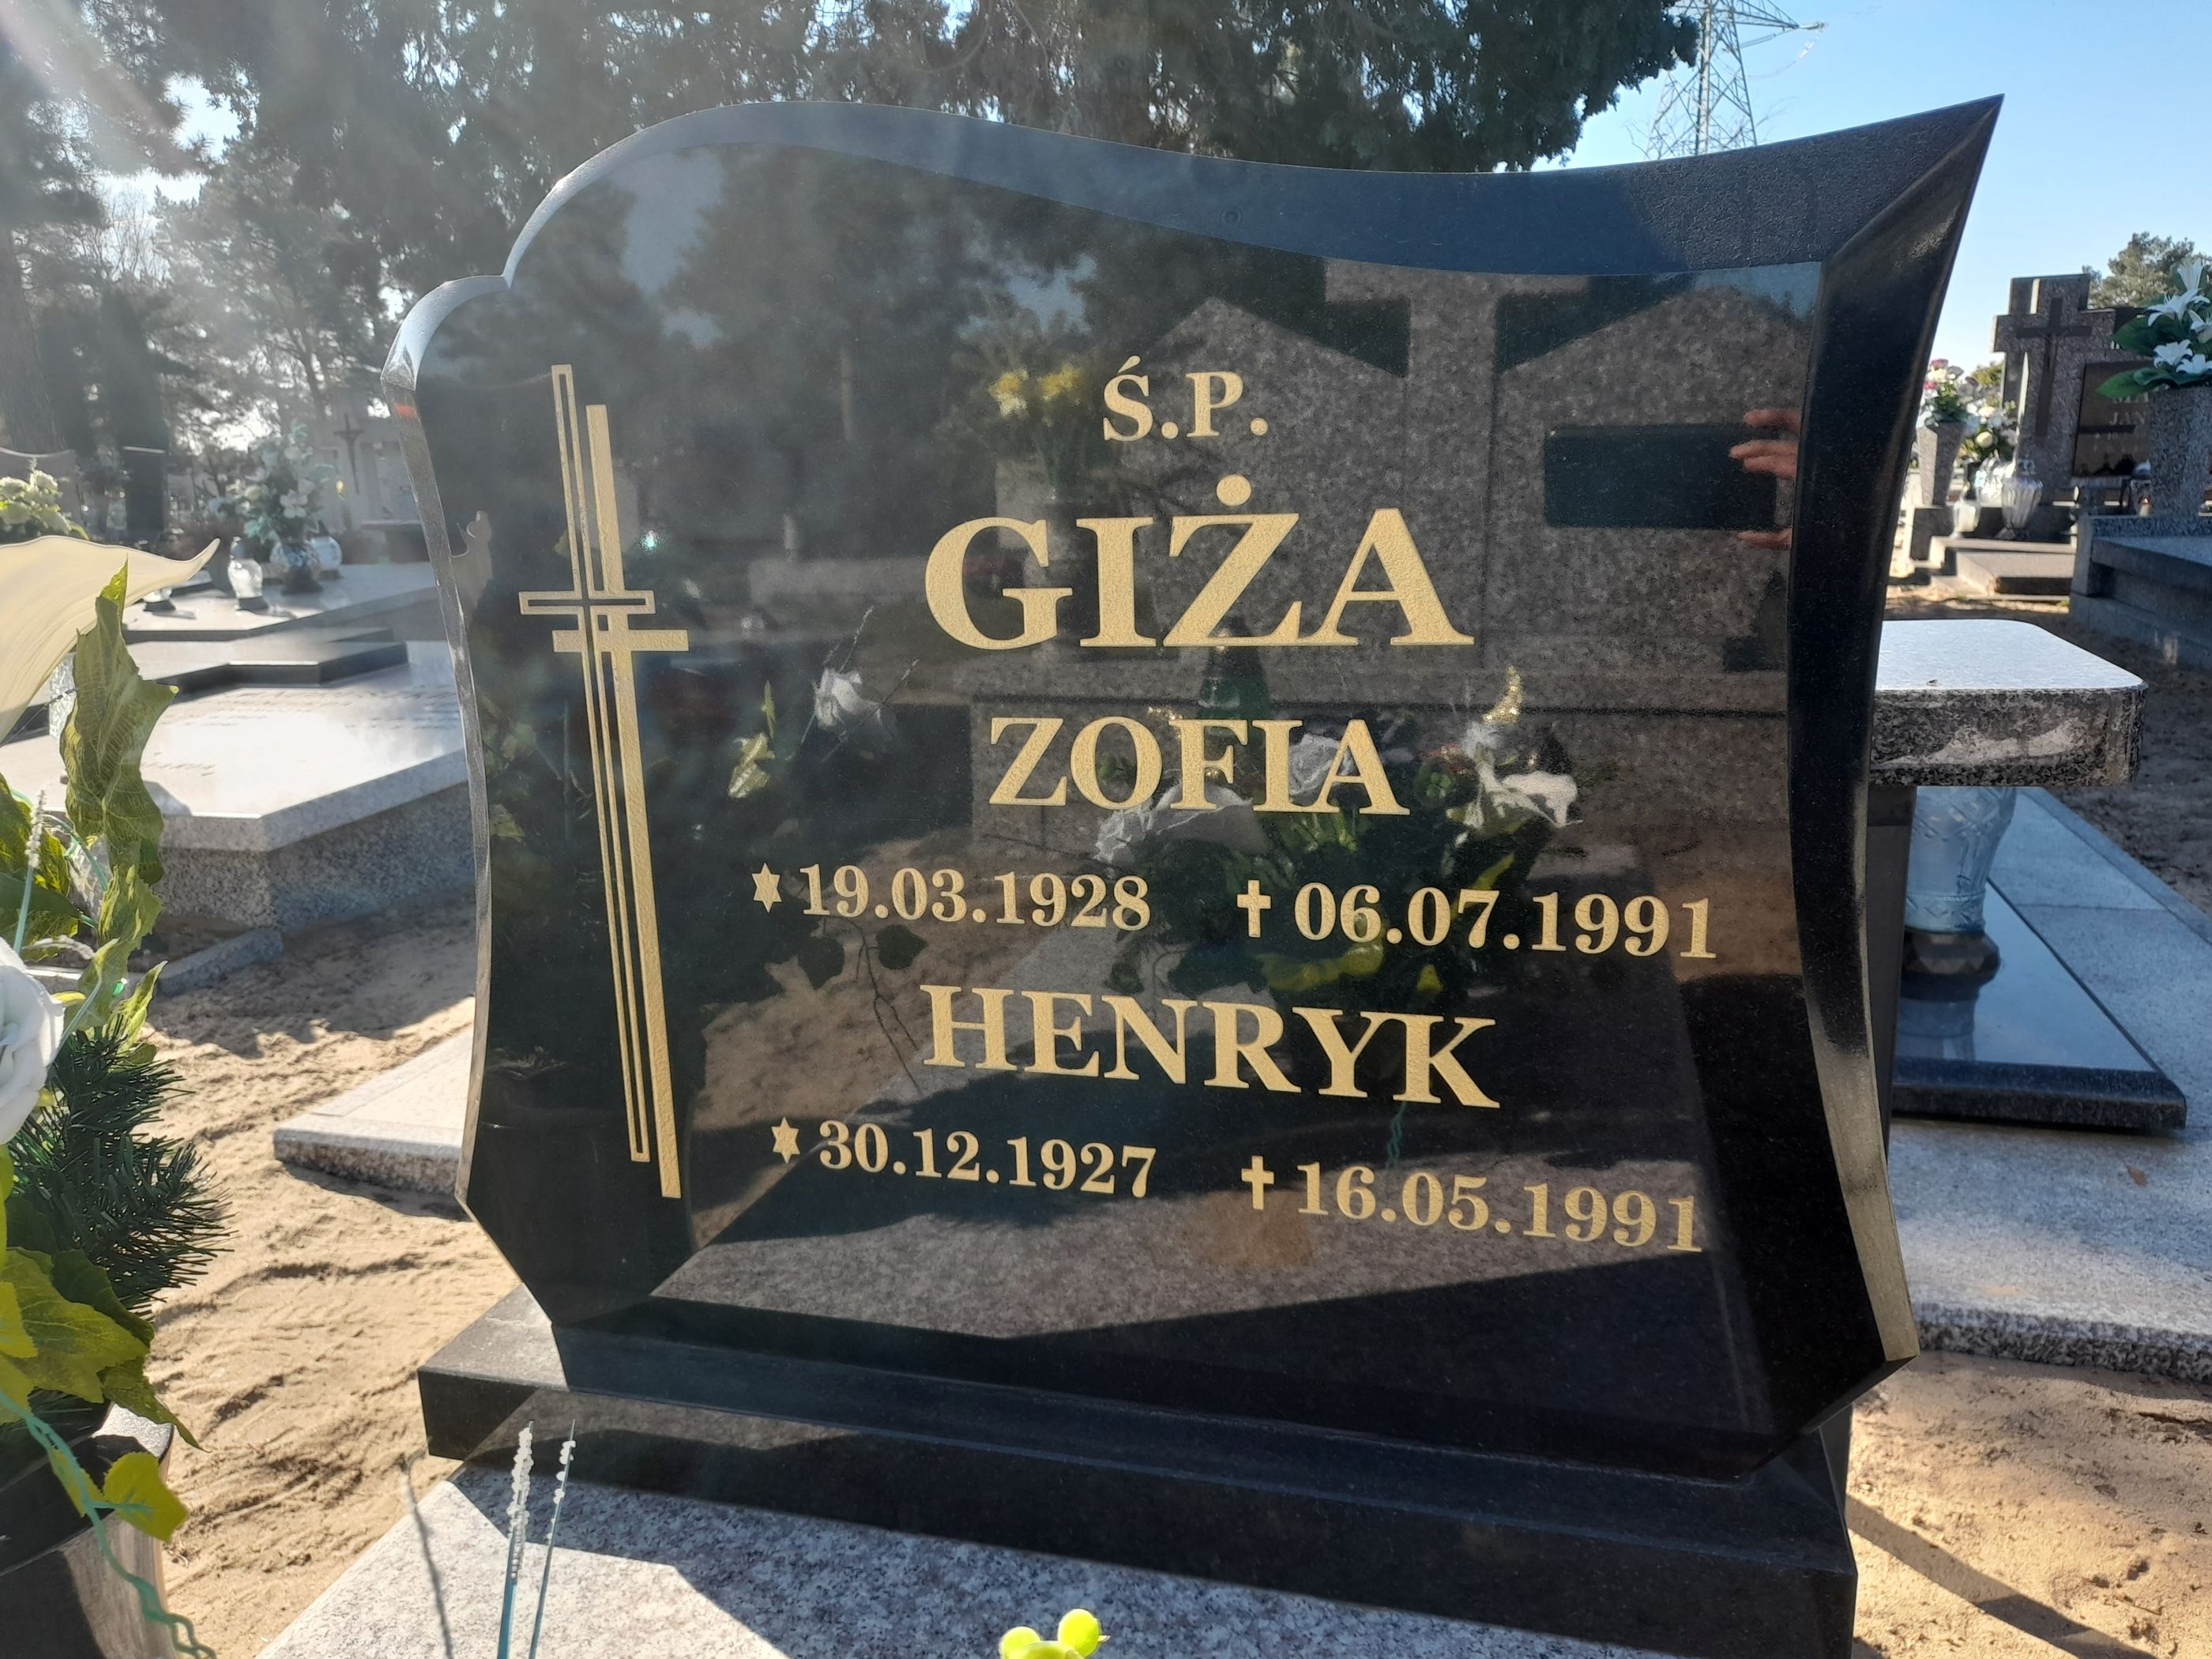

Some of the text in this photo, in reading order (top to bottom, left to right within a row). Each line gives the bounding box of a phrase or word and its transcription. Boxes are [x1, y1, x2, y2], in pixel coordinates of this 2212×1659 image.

[924, 474, 1475, 651] GIŻA
[989, 715, 1410, 816] ZOFIA
[800, 863, 1717, 959] 19.03.1928 06.07.1991
[920, 984, 1500, 1108] HENRYK
[818, 1120, 1702, 1252] 30.12.1927 16.05.1991
